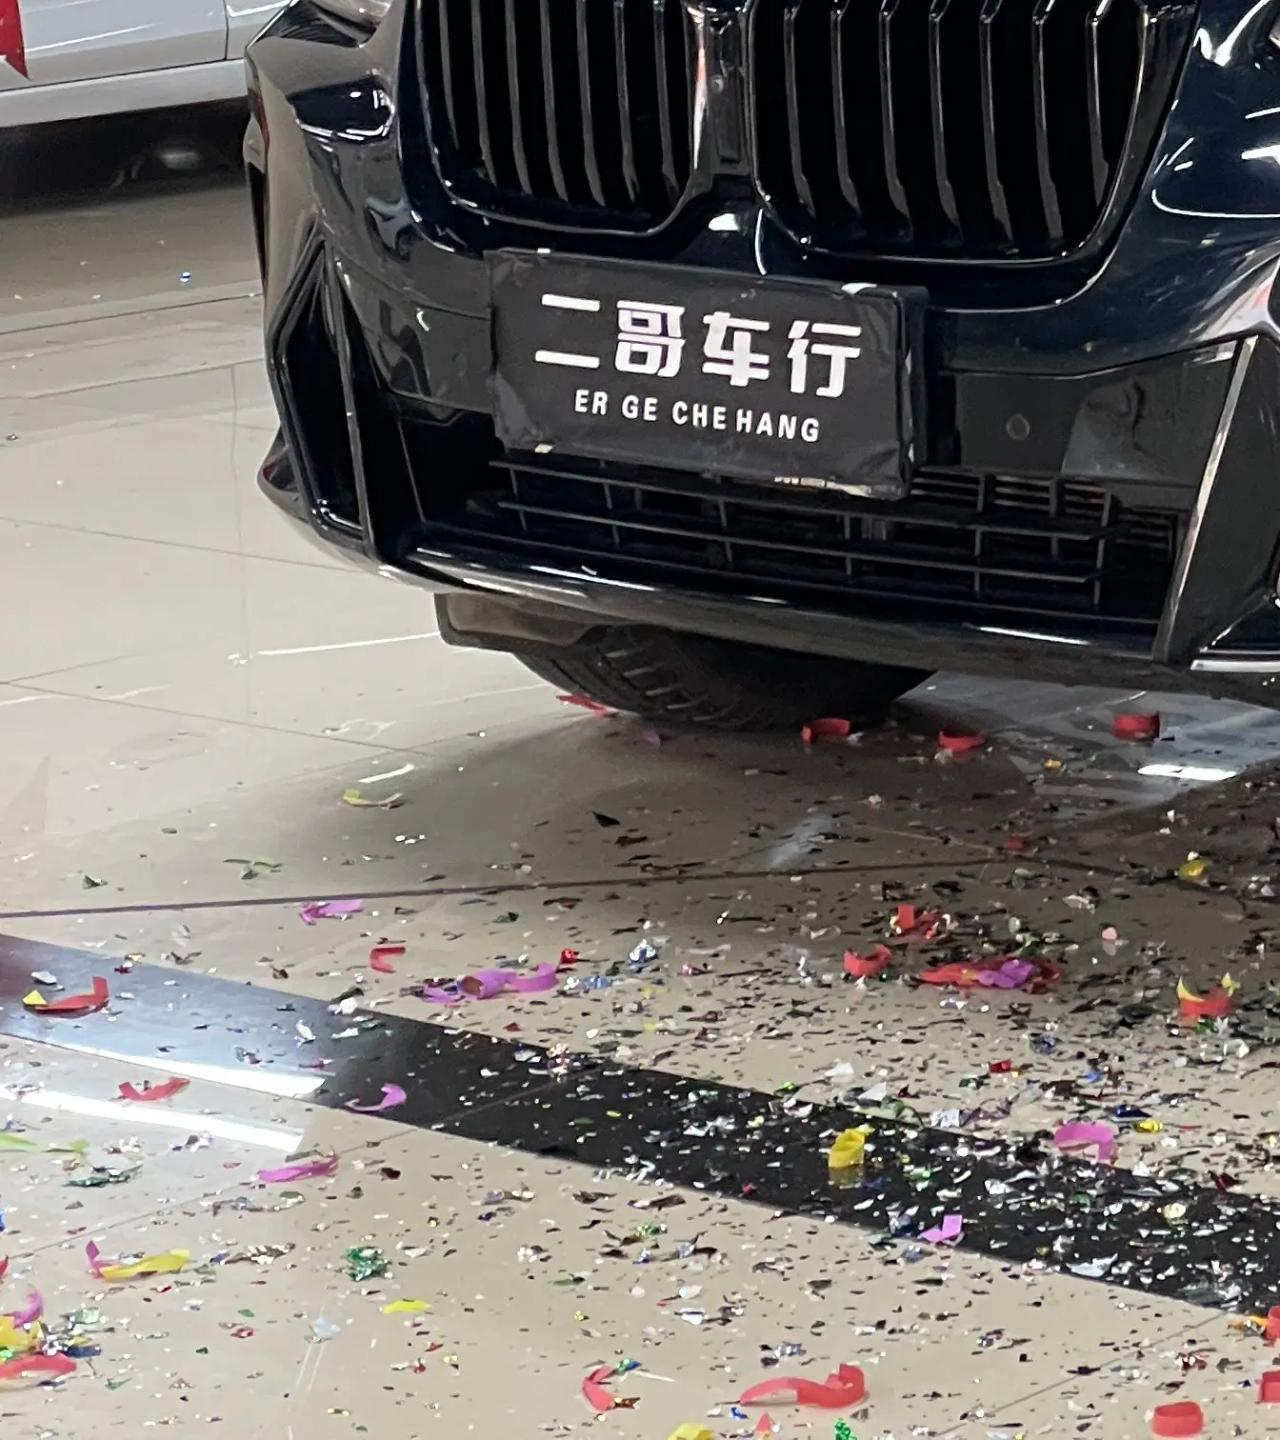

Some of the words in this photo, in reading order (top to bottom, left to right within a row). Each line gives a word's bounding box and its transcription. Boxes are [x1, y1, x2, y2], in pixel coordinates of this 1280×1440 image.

[534, 293, 862, 398] 二哥车行
[574, 389, 608, 416] ER
[621, 394, 658, 421] GE
[672, 400, 727, 430] CHE
[736, 408, 820, 442] HANG
